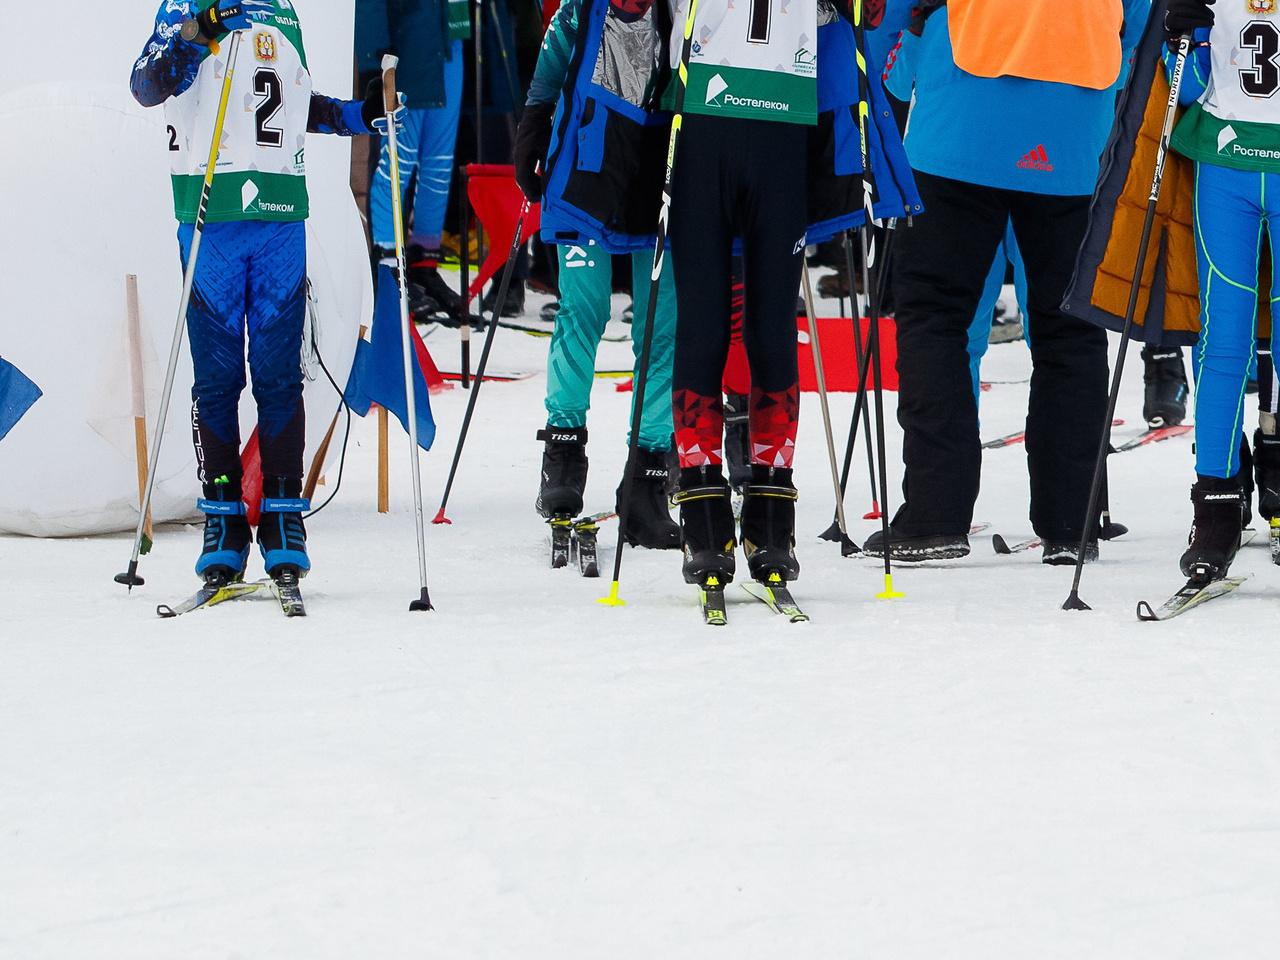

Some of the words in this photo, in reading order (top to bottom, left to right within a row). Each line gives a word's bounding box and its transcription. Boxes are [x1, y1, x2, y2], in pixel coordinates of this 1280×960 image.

[1170, 57, 1183, 103] NORDWAY
[252, 66, 284, 149] 2
[724, 94, 789, 111] Ростелеком
[166, 124, 180, 152] 2
[1016, 160, 1054, 172] adidas
[551, 433, 578, 441] TISA
[645, 469, 668, 477] TISA
